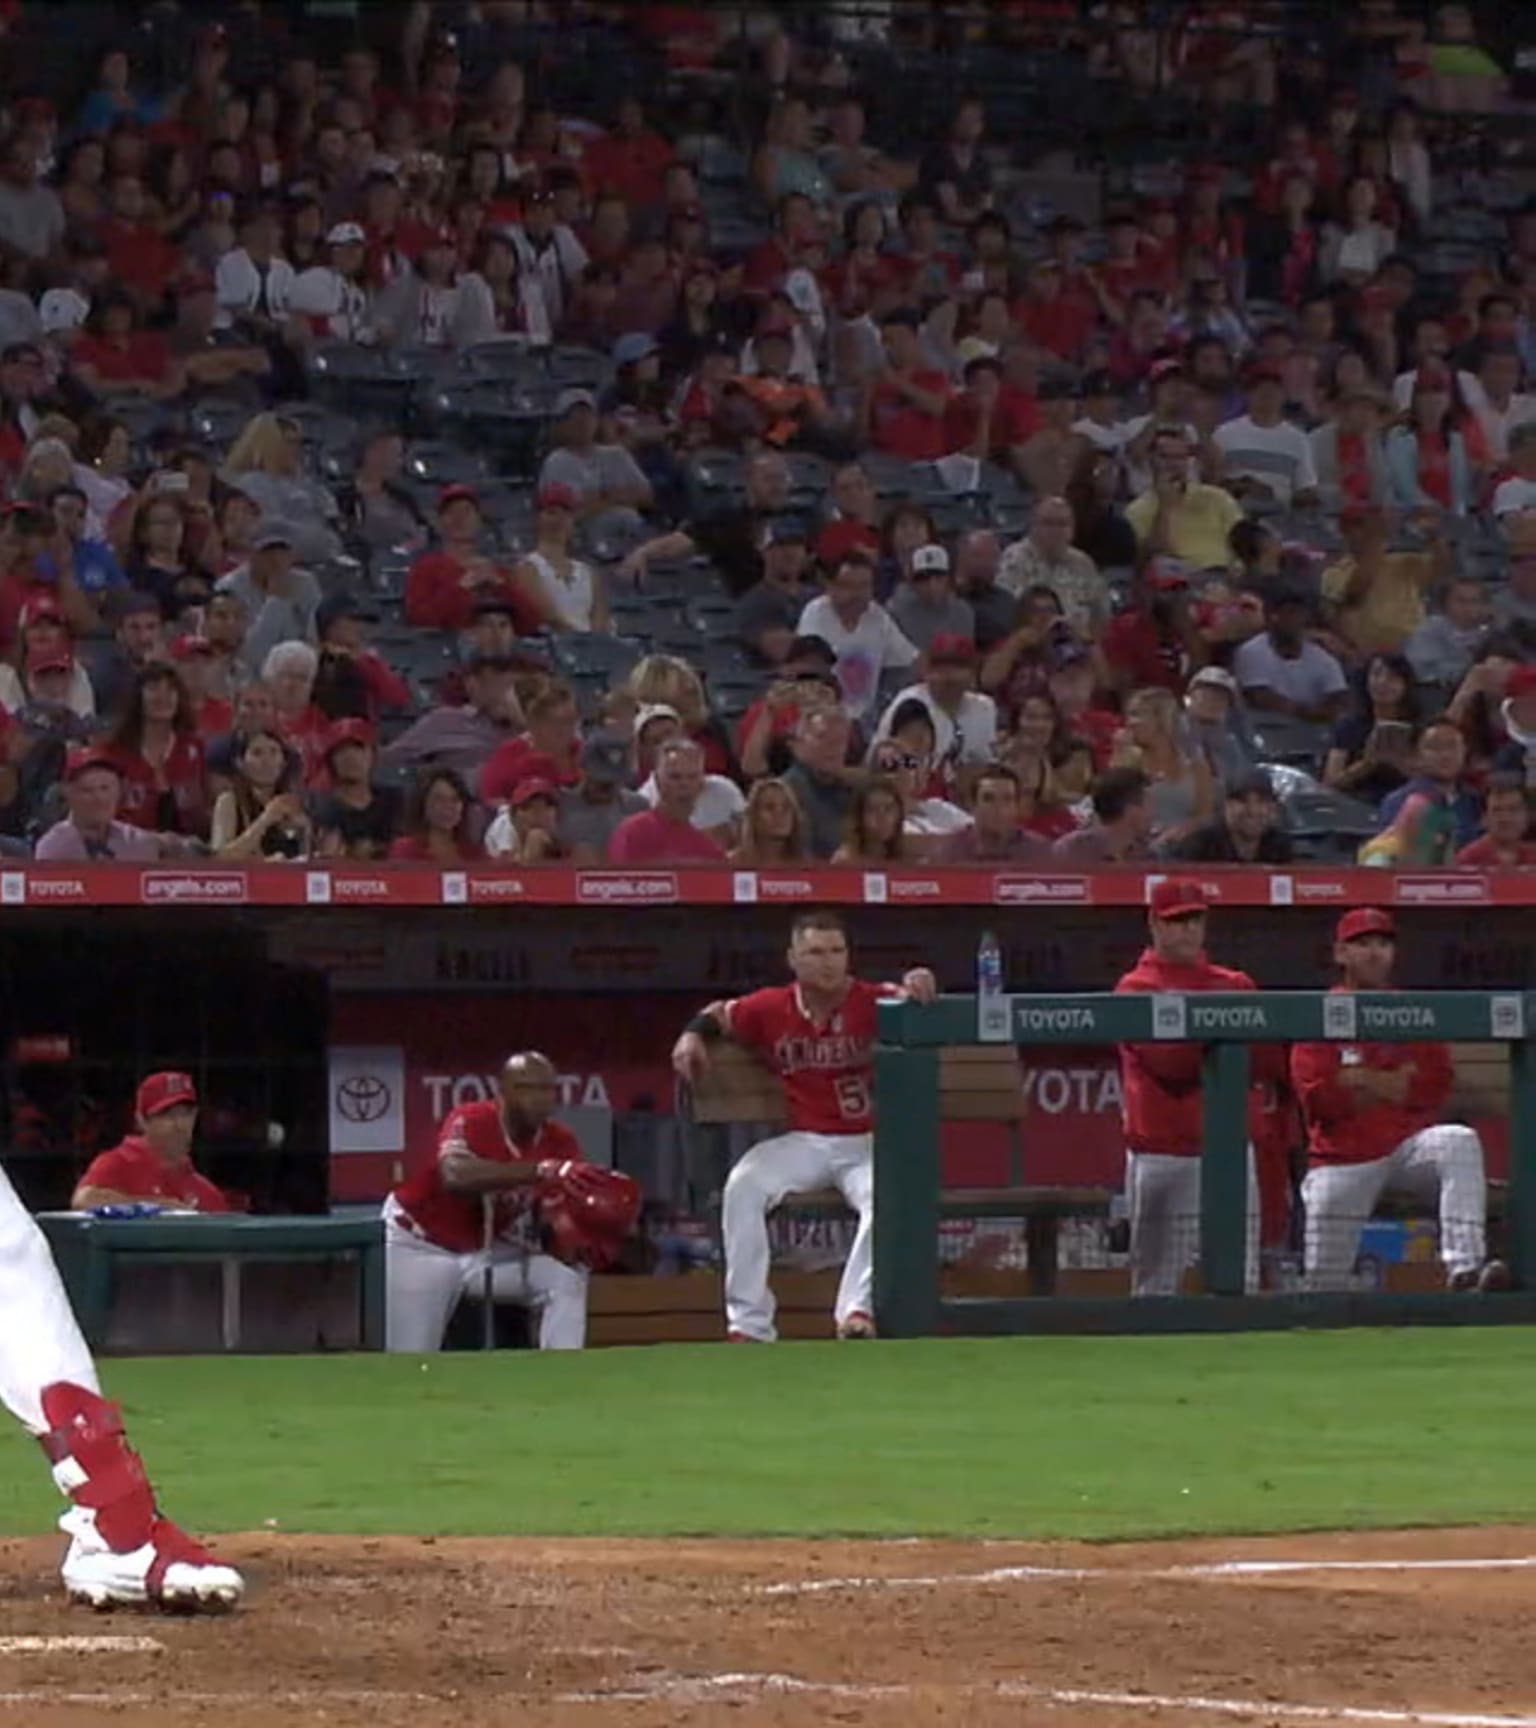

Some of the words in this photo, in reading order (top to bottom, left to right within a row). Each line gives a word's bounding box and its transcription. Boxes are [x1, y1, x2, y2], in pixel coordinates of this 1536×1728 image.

[29, 880, 85, 896] TOYOTA
[334, 880, 388, 895] TOYOTA
[471, 879, 523, 895] TOYOTA
[1017, 1008, 1096, 1029] TOYOTA
[1191, 1007, 1267, 1027] TOYOTA
[1362, 1006, 1436, 1027] TOYOTA
